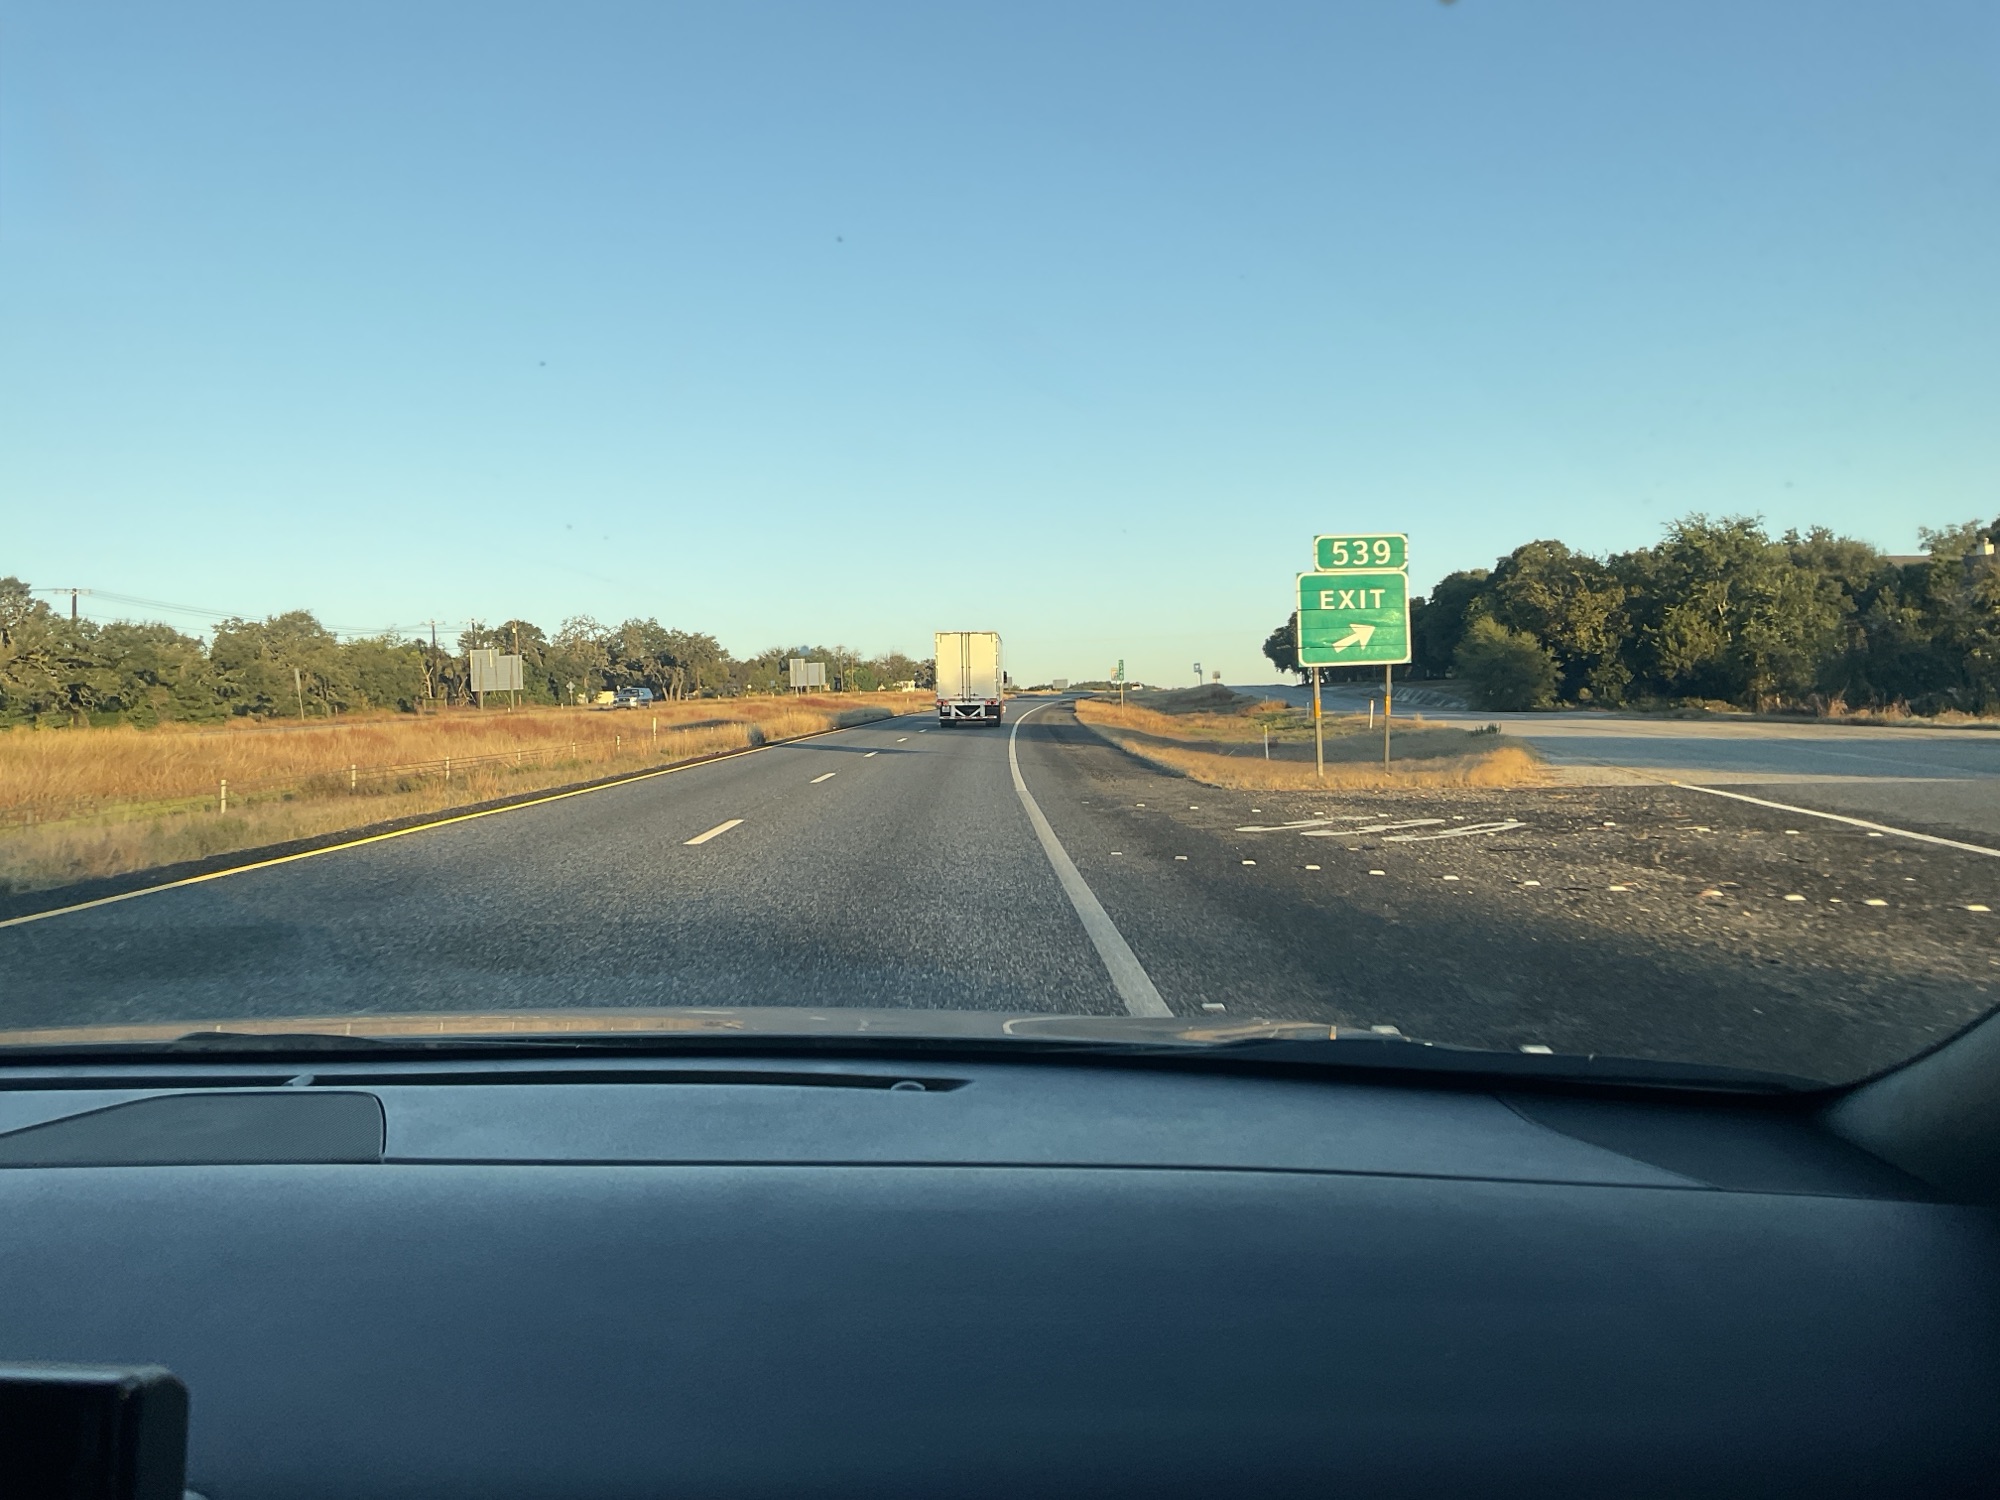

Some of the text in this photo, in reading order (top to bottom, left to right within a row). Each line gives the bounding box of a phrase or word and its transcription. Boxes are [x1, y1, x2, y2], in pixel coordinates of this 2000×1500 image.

[1332, 539, 1391, 565] 539
[1319, 588, 1386, 610] EXIT
[1235, 816, 1526, 842] 539
